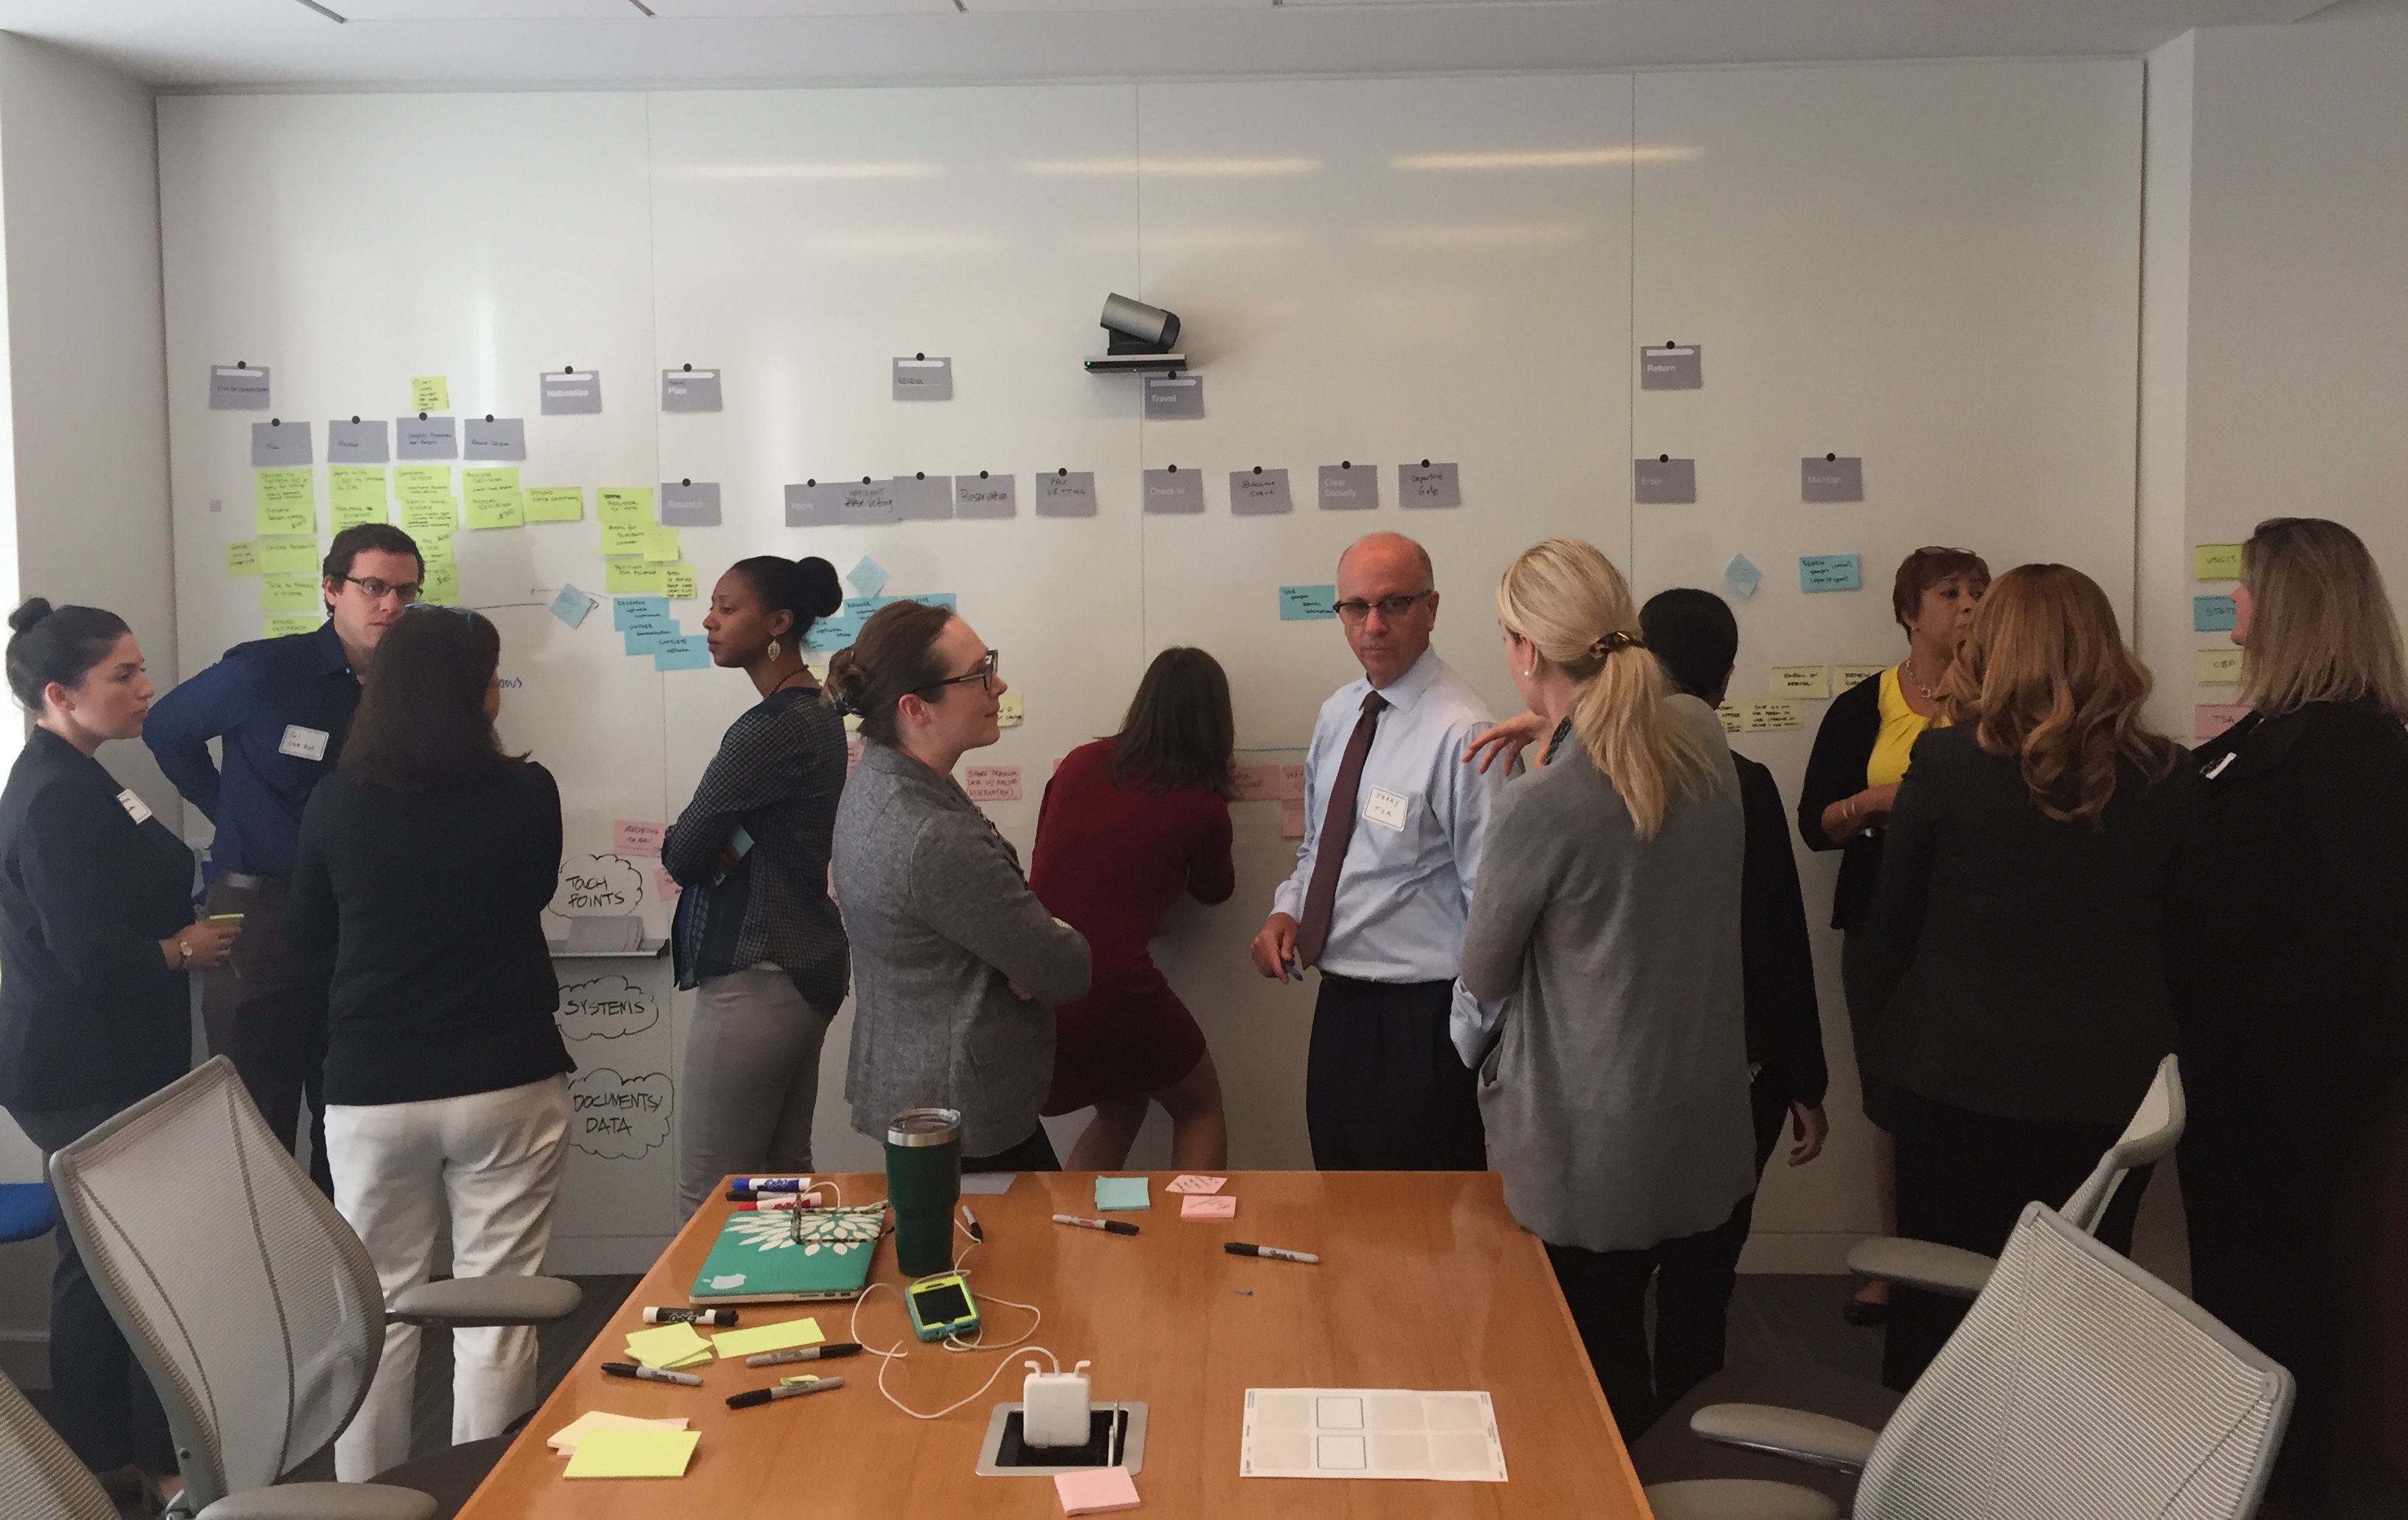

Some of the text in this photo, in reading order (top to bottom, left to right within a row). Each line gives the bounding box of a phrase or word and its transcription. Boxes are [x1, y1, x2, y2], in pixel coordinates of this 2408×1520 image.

[1647, 364, 1676, 372] Return
[1151, 395, 1177, 403] Travel
[2213, 659, 2236, 669] CBP
[2213, 712, 2235, 723] TSA
[568, 890, 625, 909] POINTS
[564, 999, 645, 1016] SYSTEMS
[586, 1116, 634, 1136] DATA
